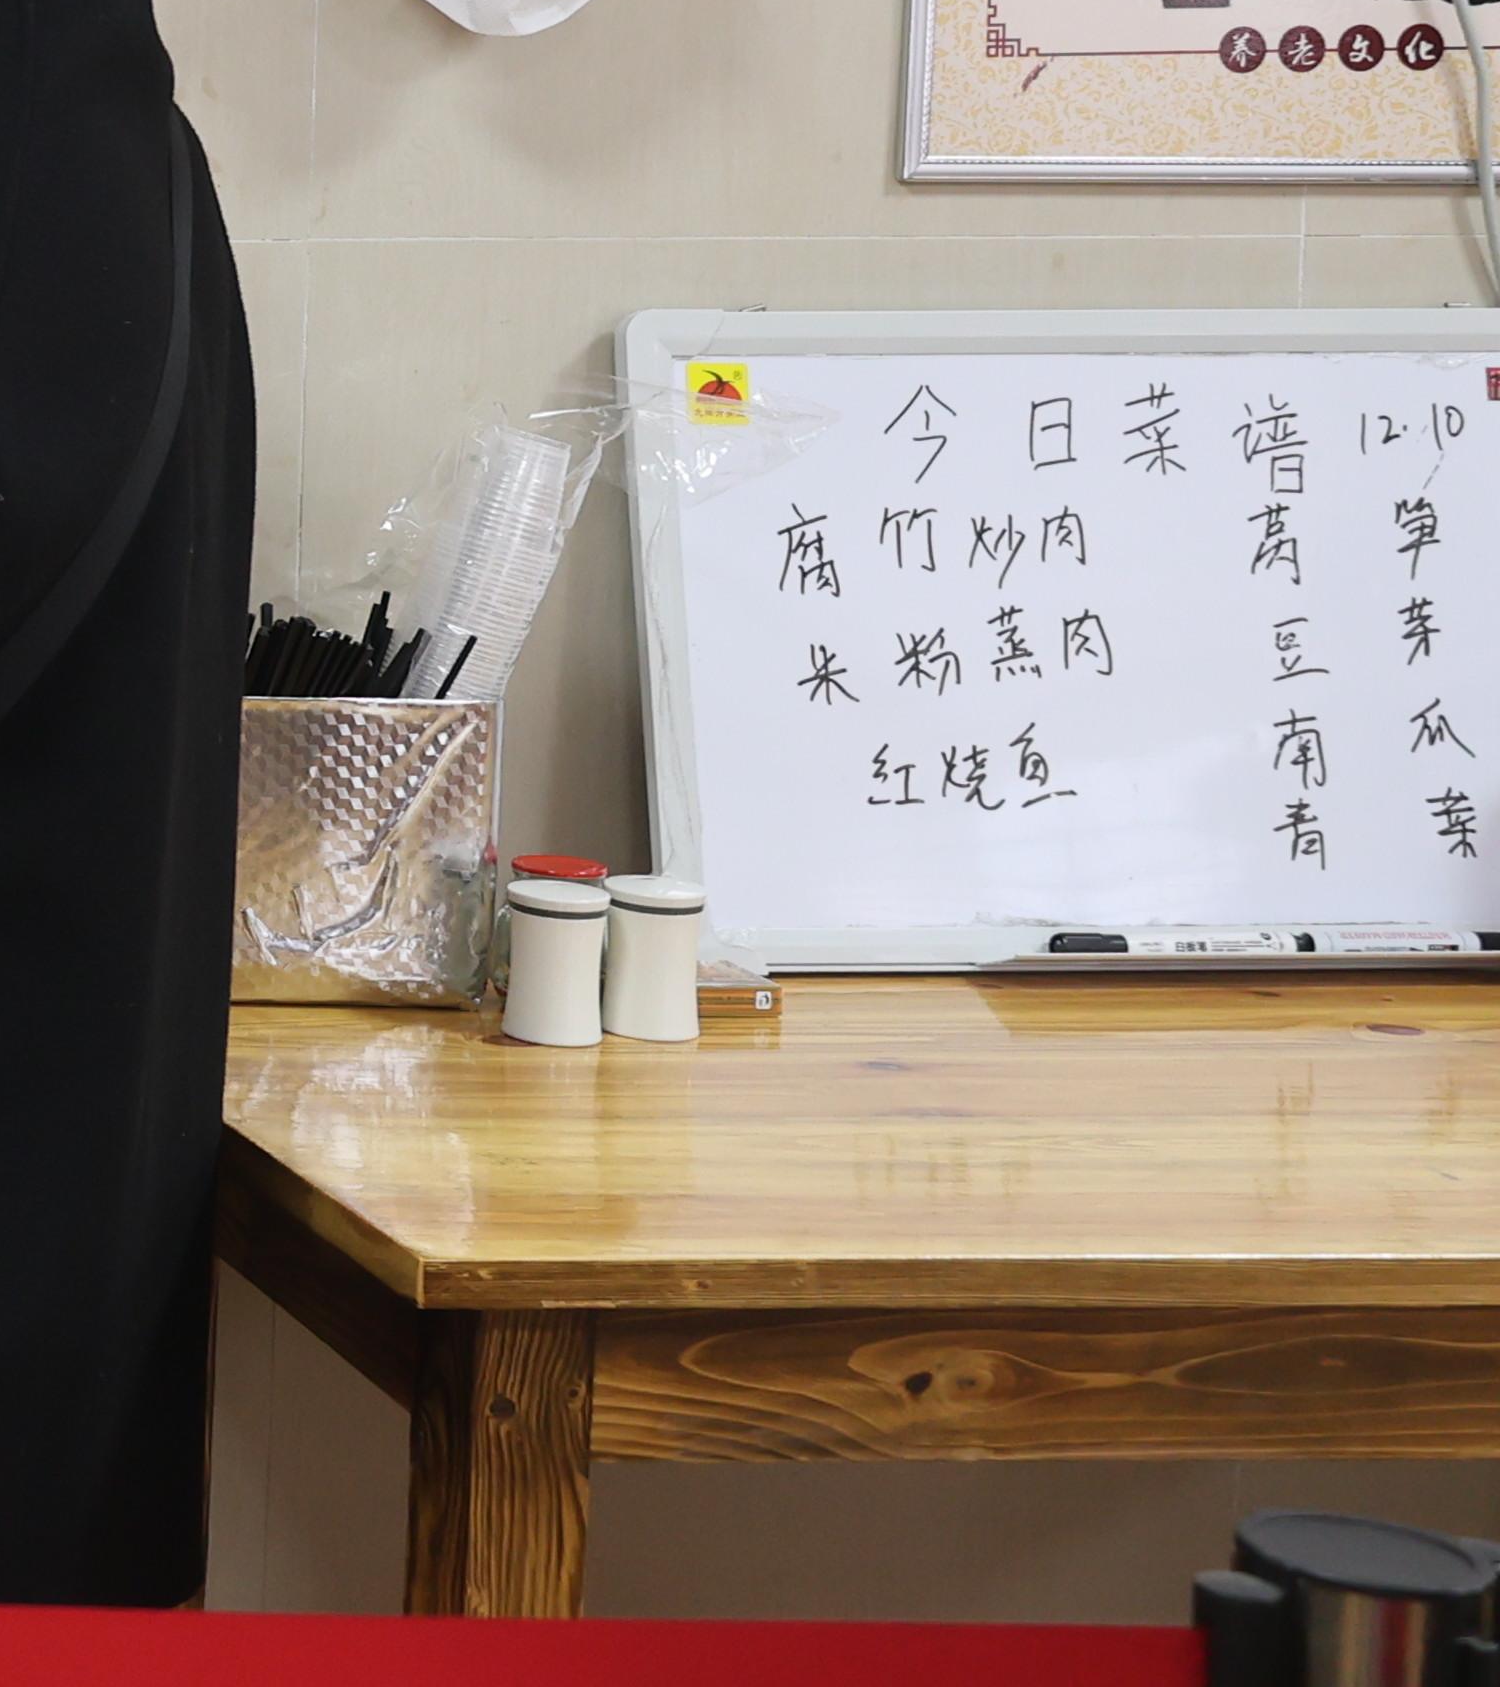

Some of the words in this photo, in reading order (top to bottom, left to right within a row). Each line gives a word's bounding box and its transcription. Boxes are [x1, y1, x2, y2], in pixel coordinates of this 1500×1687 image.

[1226, 30, 1437, 68] 养老文化
[884, 383, 1309, 495] 今日菜谱
[777, 502, 1087, 598] 腐竹炒肉
[797, 605, 1113, 705] 米粉蒸肉
[867, 722, 1078, 811] 红烧鱼
[1273, 697, 1477, 790] 南瓜
